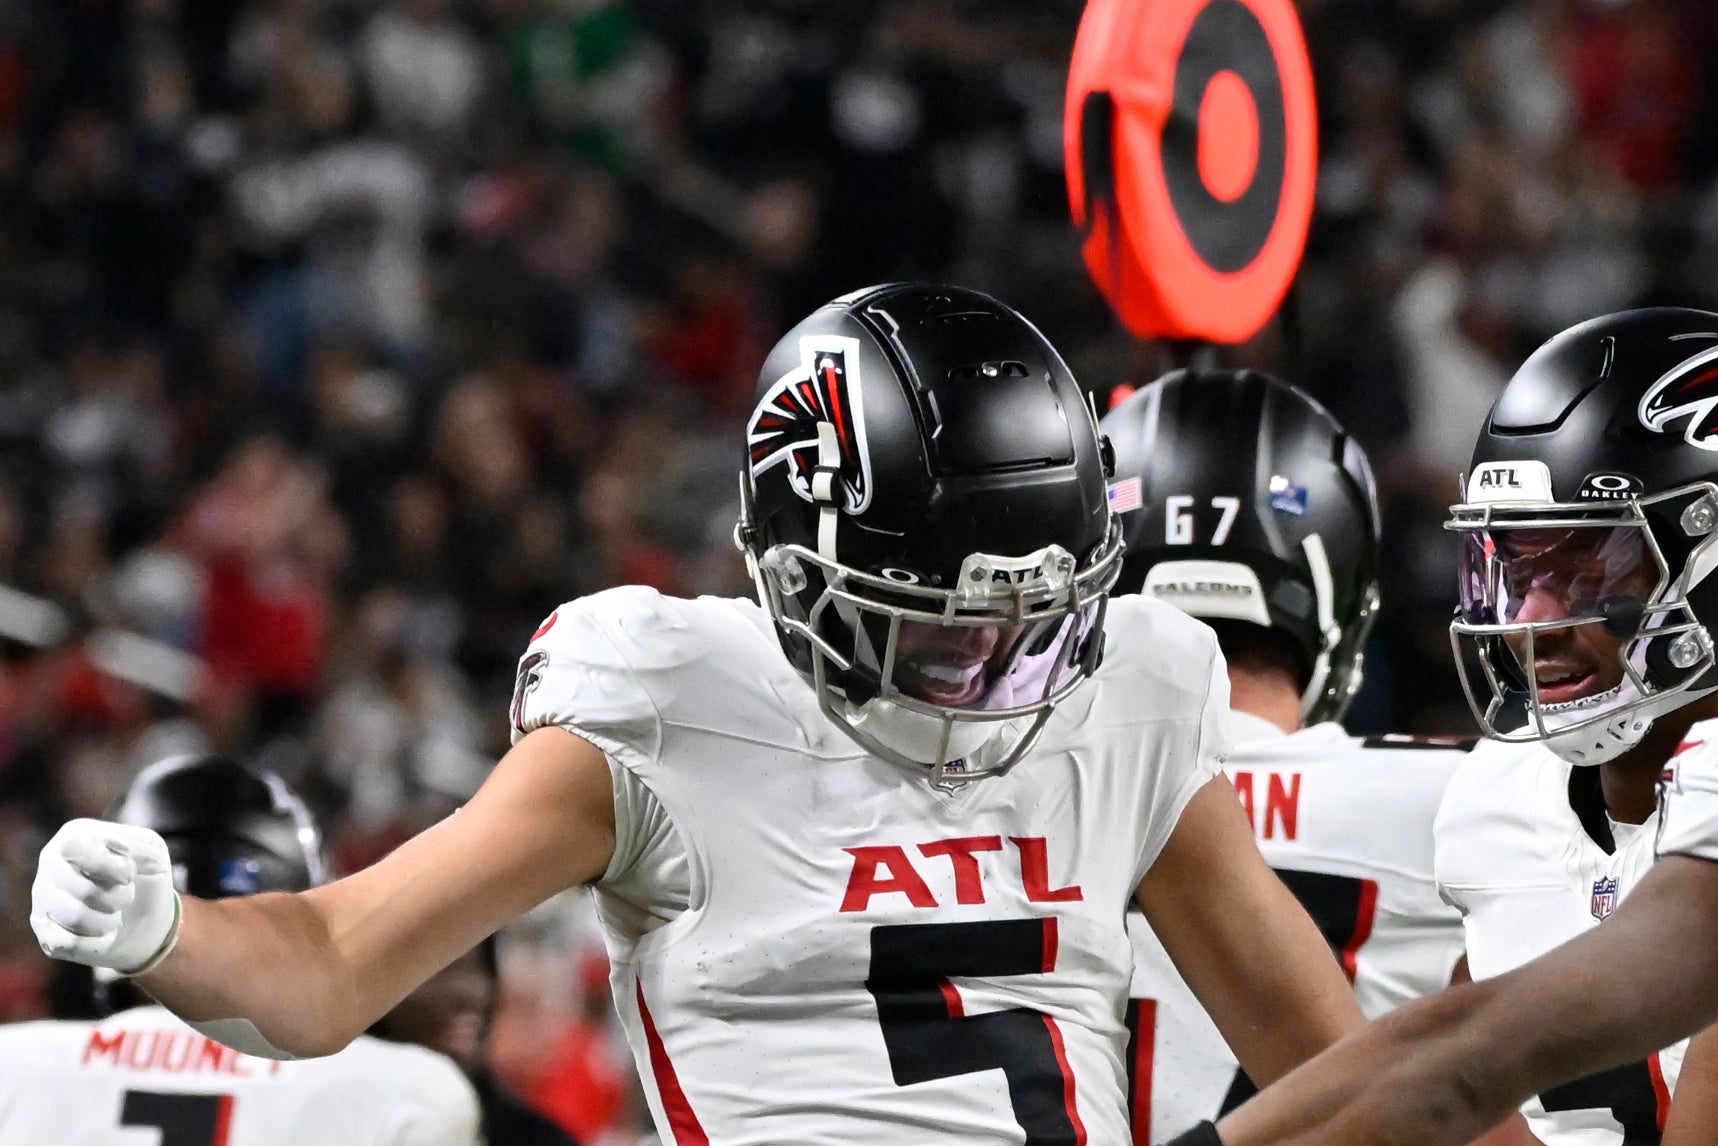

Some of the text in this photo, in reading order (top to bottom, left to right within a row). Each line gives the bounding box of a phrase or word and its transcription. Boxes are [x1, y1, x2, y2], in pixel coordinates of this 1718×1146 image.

[1480, 469, 1521, 488] ATL
[1581, 489, 1639, 500] OAKLEY
[1165, 495, 1240, 546] 67
[840, 834, 1084, 912] ATL
[1593, 895, 1613, 916] NFL
